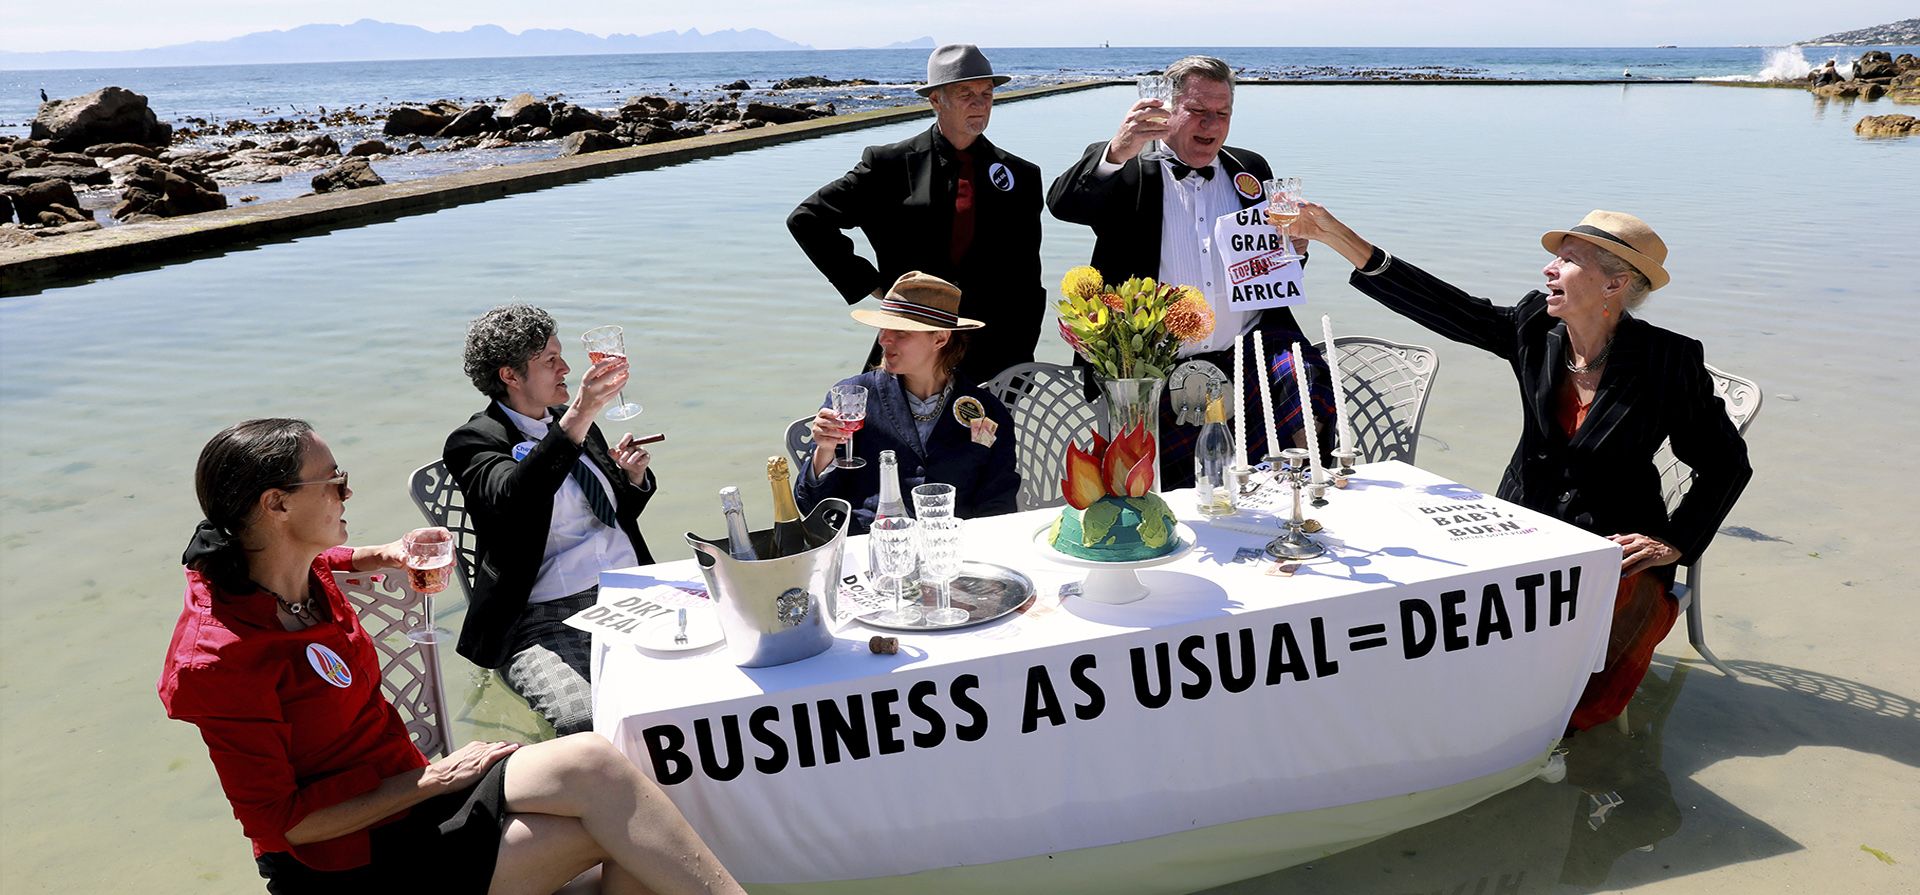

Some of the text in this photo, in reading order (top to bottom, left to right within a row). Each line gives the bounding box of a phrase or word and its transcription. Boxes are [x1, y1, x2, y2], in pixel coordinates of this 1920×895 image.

[1231, 233, 1280, 252] GRAB
[1232, 263, 1249, 280] TOP
[1231, 280, 1301, 303] AFRICA
[1447, 521, 1521, 537] BURN
[612, 596, 676, 618] DIRT
[581, 606, 642, 634] DEAL
[642, 673, 988, 786] BUSINESS
[1021, 654, 1106, 734] AS
[1129, 616, 1339, 709] USUAL
[1399, 565, 1582, 660] DEATH
